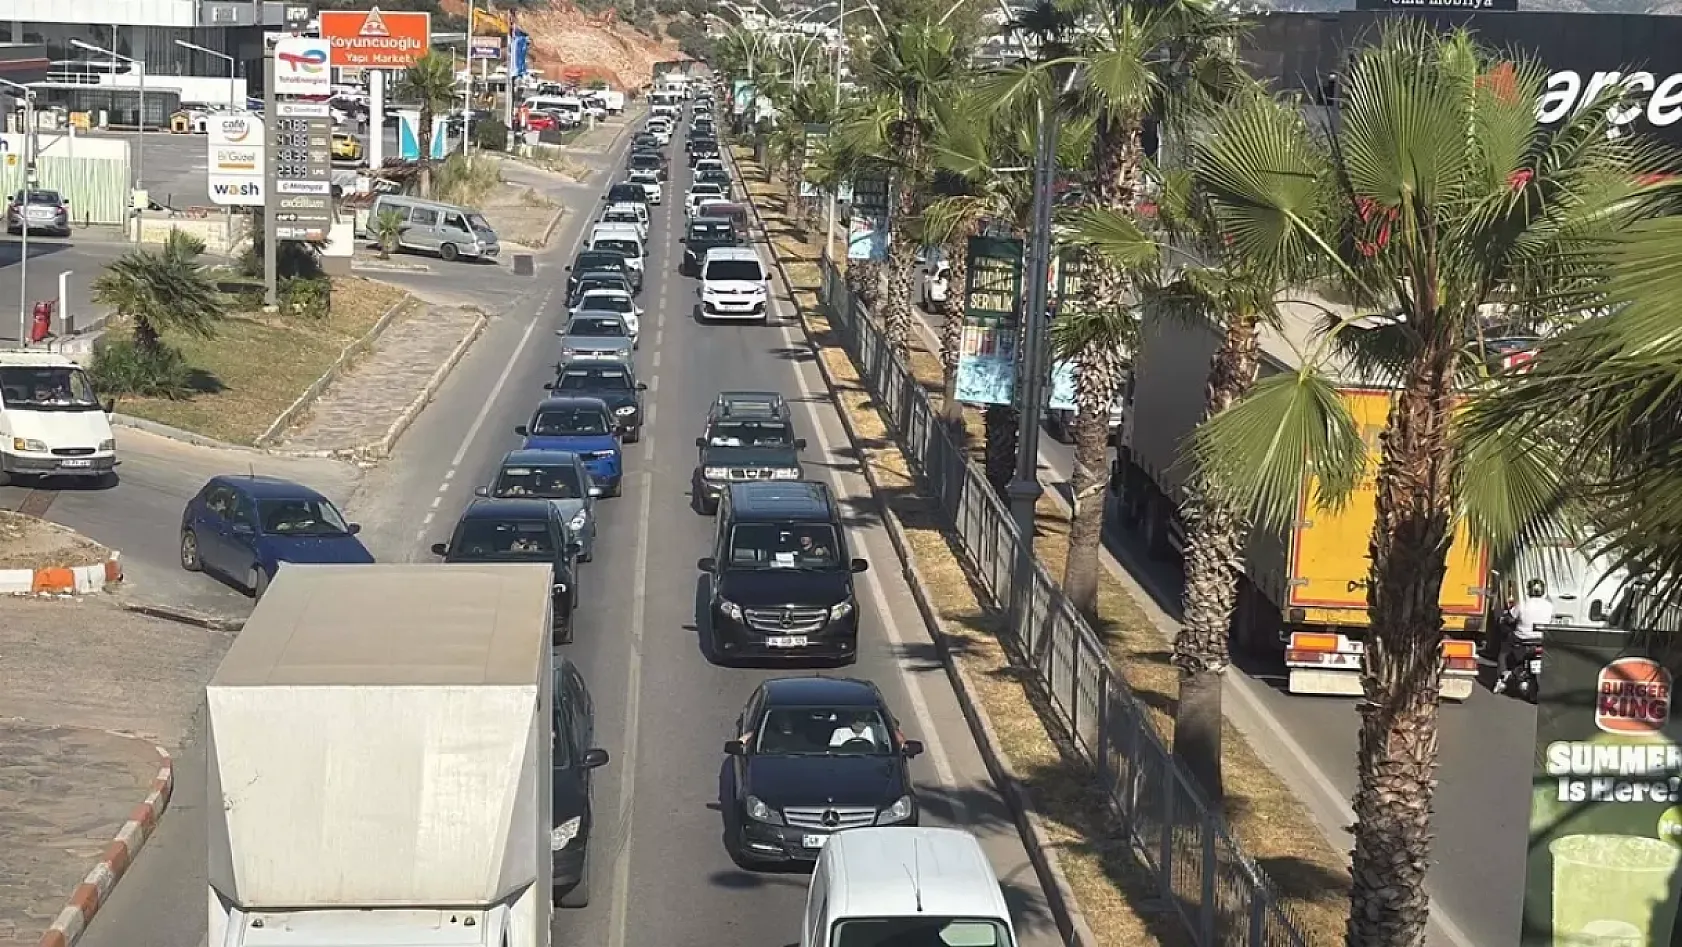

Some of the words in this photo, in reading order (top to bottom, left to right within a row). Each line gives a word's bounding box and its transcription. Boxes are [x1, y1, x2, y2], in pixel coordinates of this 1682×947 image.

[222, 119, 245, 128] café
[214, 182, 259, 196] wash
[1601, 681, 1669, 698] BURGER
[1599, 697, 1668, 719] KING
[1547, 741, 1682, 775] SUMMER
[1557, 777, 1586, 802] Is
[1590, 776, 1681, 802] Here!
